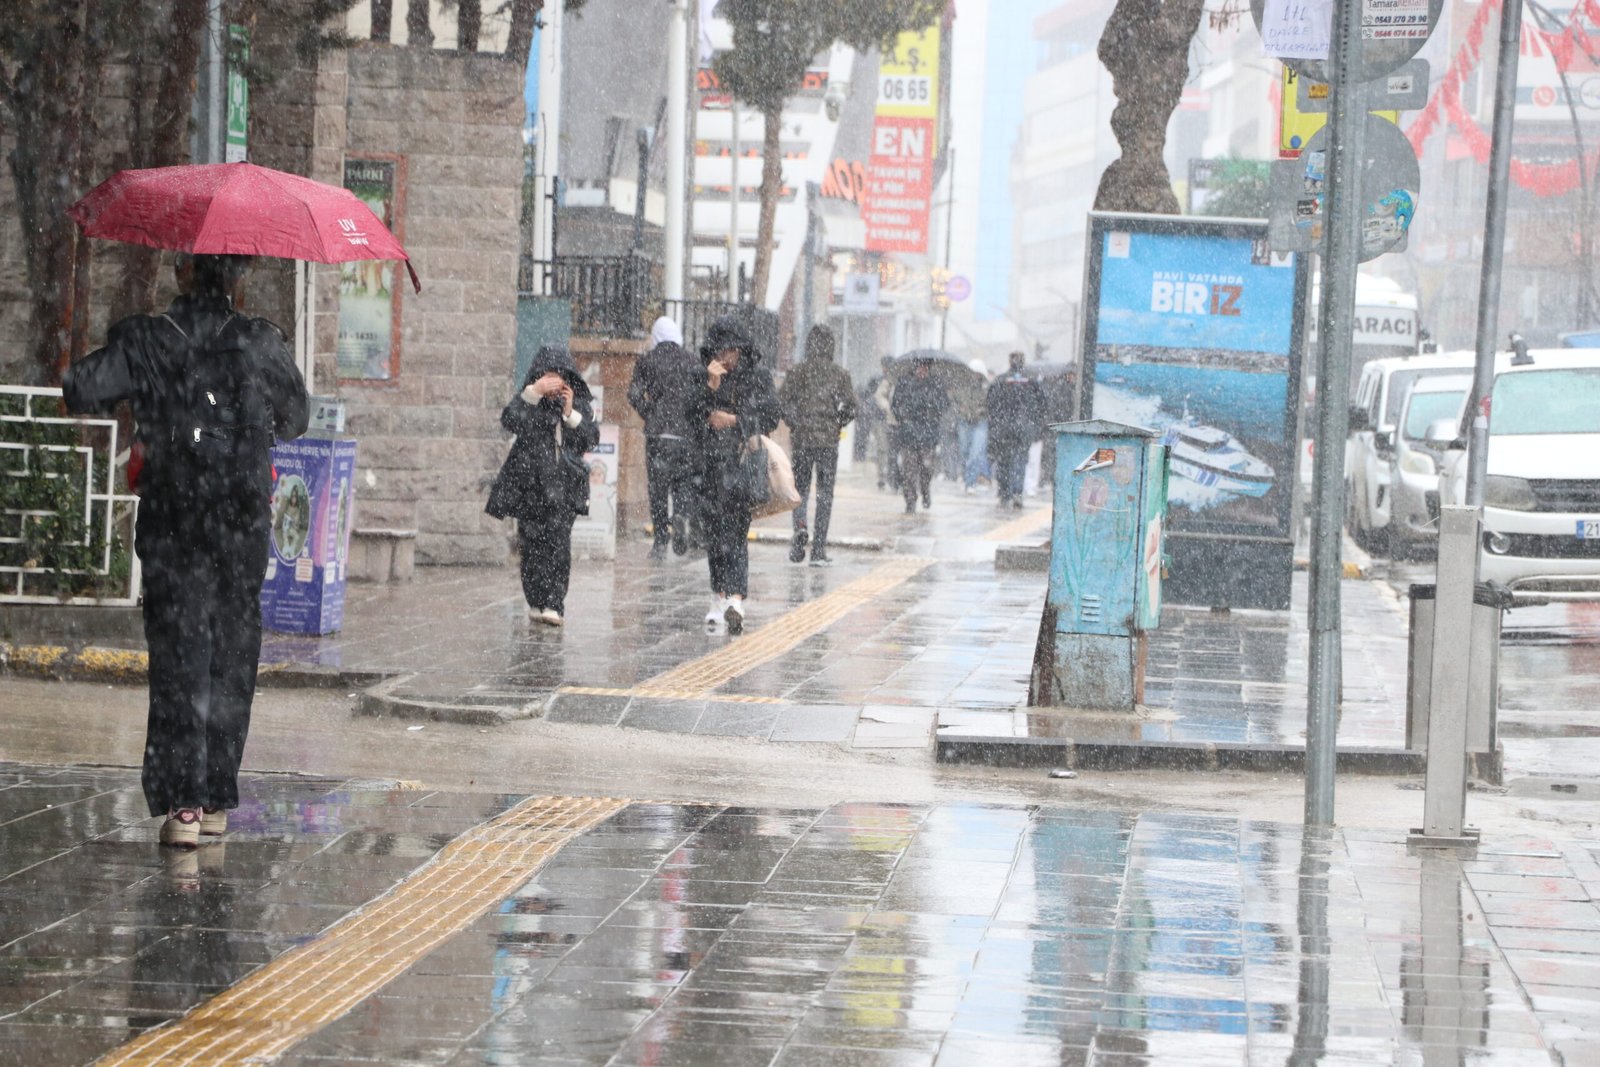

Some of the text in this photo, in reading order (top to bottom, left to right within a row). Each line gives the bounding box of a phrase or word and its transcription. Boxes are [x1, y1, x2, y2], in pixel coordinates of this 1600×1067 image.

[874, 126, 926, 158] EN
[337, 218, 357, 232] UV
[1187, 273, 1244, 284] VATANDA
